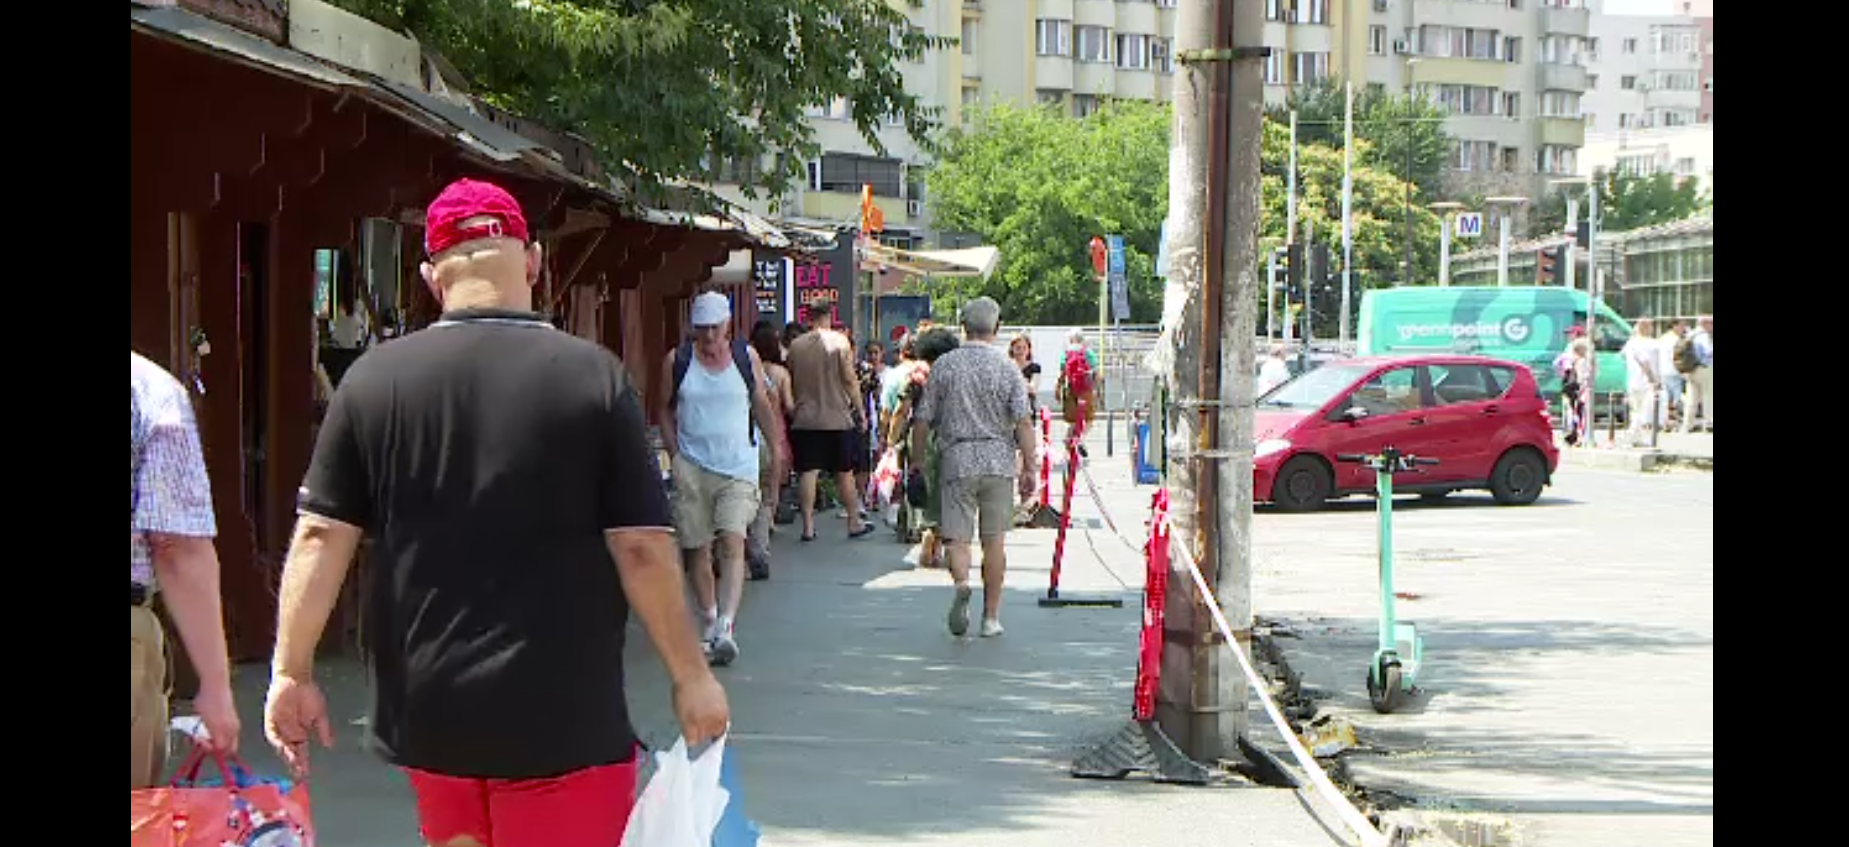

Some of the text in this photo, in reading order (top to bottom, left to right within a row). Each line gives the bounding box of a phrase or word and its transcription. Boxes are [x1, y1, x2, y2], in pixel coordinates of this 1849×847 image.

[1460, 216, 1479, 233] M
[796, 265, 832, 286] EAT
[798, 307, 843, 325] FL
